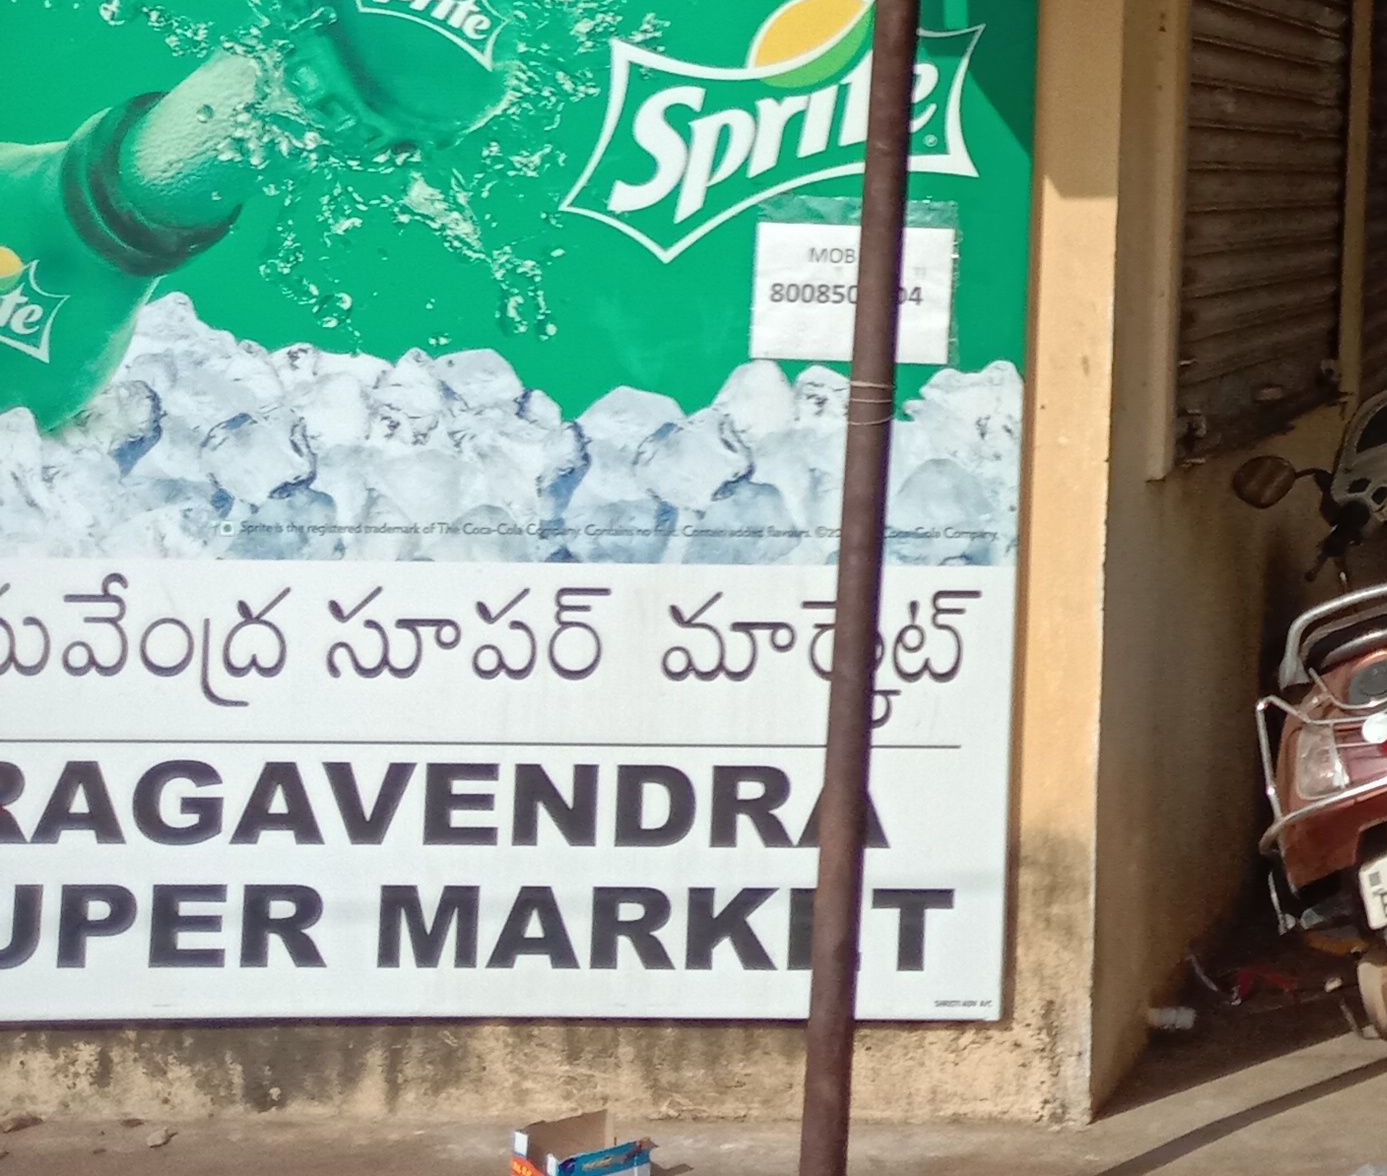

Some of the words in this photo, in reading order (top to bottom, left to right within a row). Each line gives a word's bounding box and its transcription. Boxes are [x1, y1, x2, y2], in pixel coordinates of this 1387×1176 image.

[770, 282, 924, 306] 80085004
[422, 523, 436, 535] of
[325, 585, 612, 682] సూపర్
[0, 883, 326, 970] UPER
